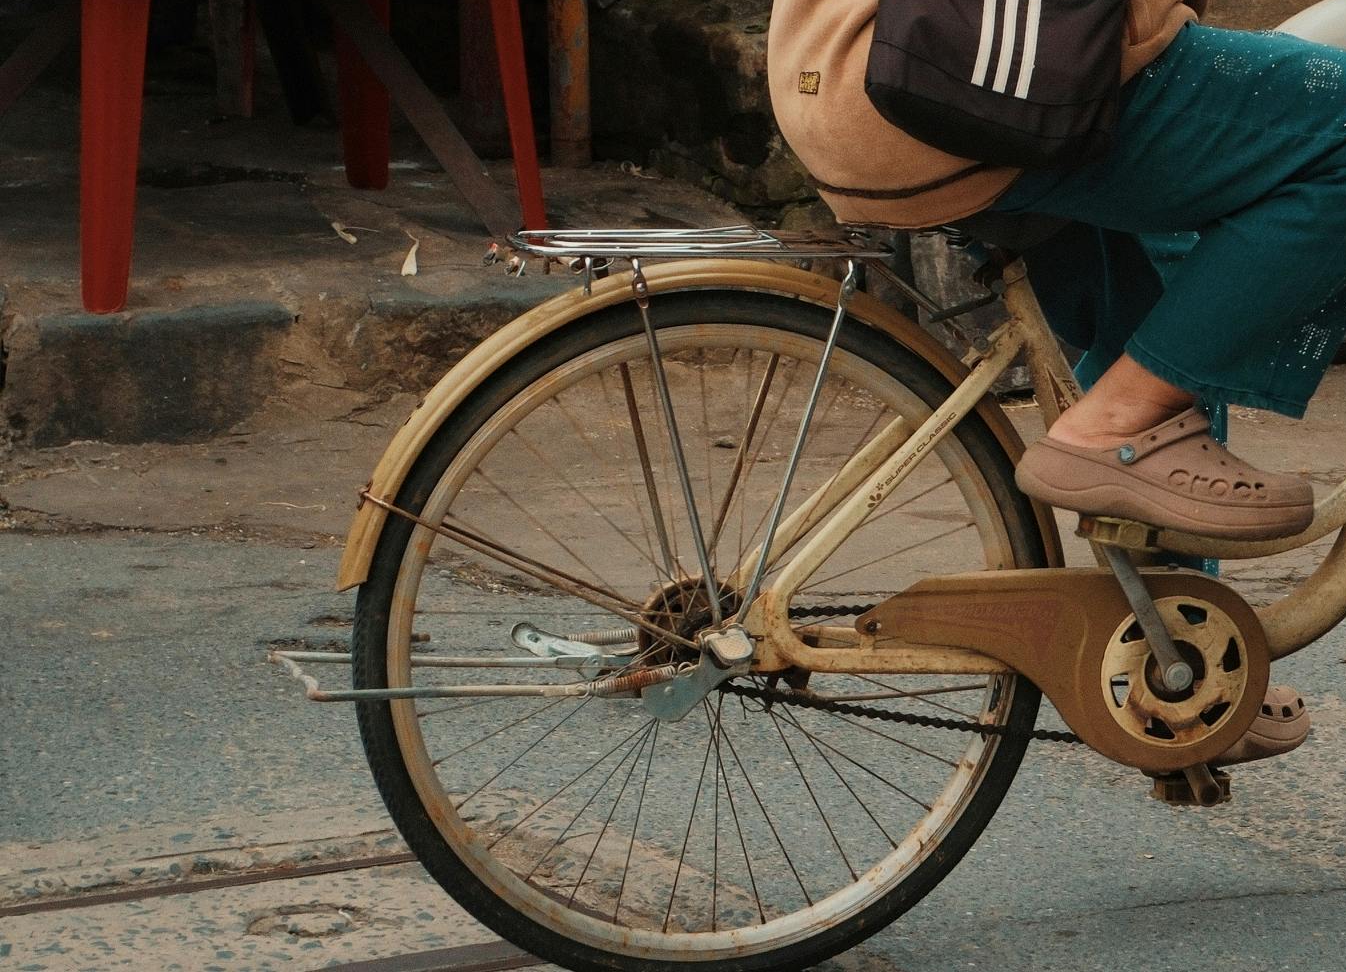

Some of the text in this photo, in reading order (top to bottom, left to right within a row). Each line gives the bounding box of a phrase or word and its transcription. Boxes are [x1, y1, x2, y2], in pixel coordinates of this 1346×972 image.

[885, 411, 957, 486] SUPER CLASSIC
[1167, 468, 1267, 500] crocs
